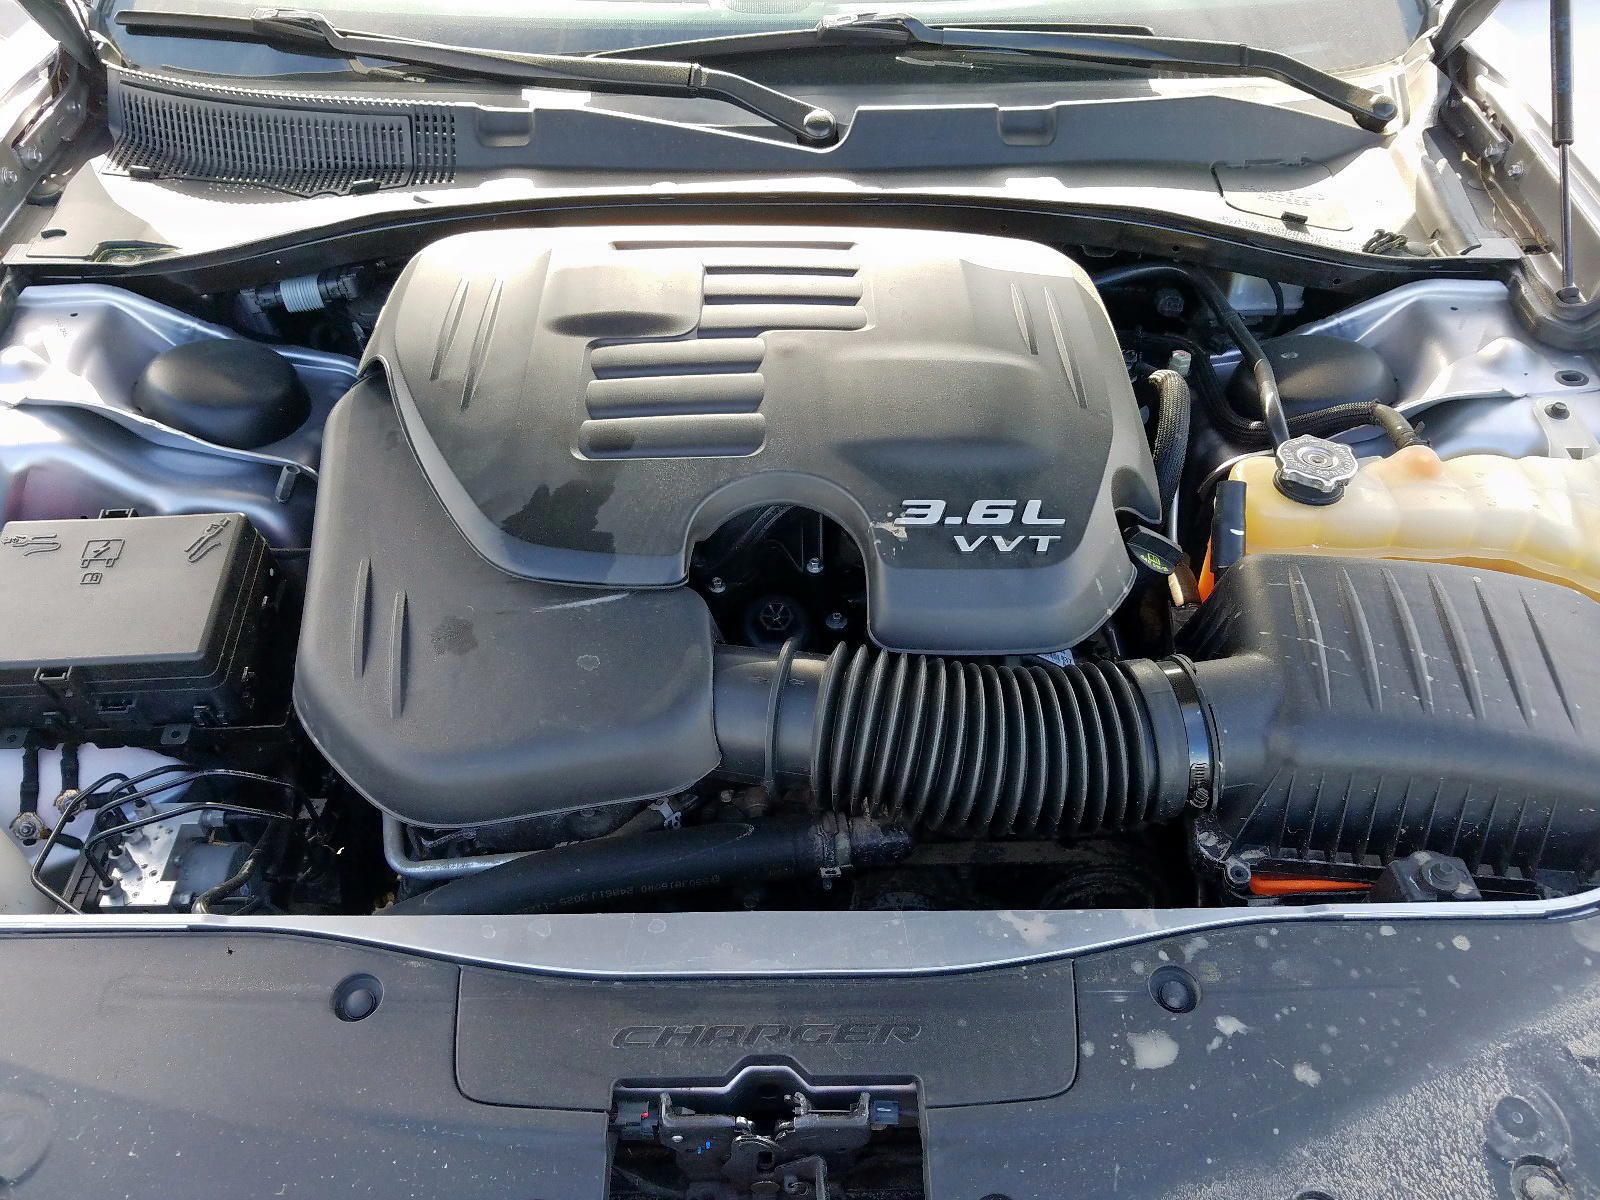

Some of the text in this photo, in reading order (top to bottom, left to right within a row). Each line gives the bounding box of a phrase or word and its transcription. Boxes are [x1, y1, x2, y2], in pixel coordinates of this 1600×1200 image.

[894, 499, 1066, 525] 3.6L
[953, 535, 1062, 552] VVT
[611, 1023, 922, 1048] CHARGER
